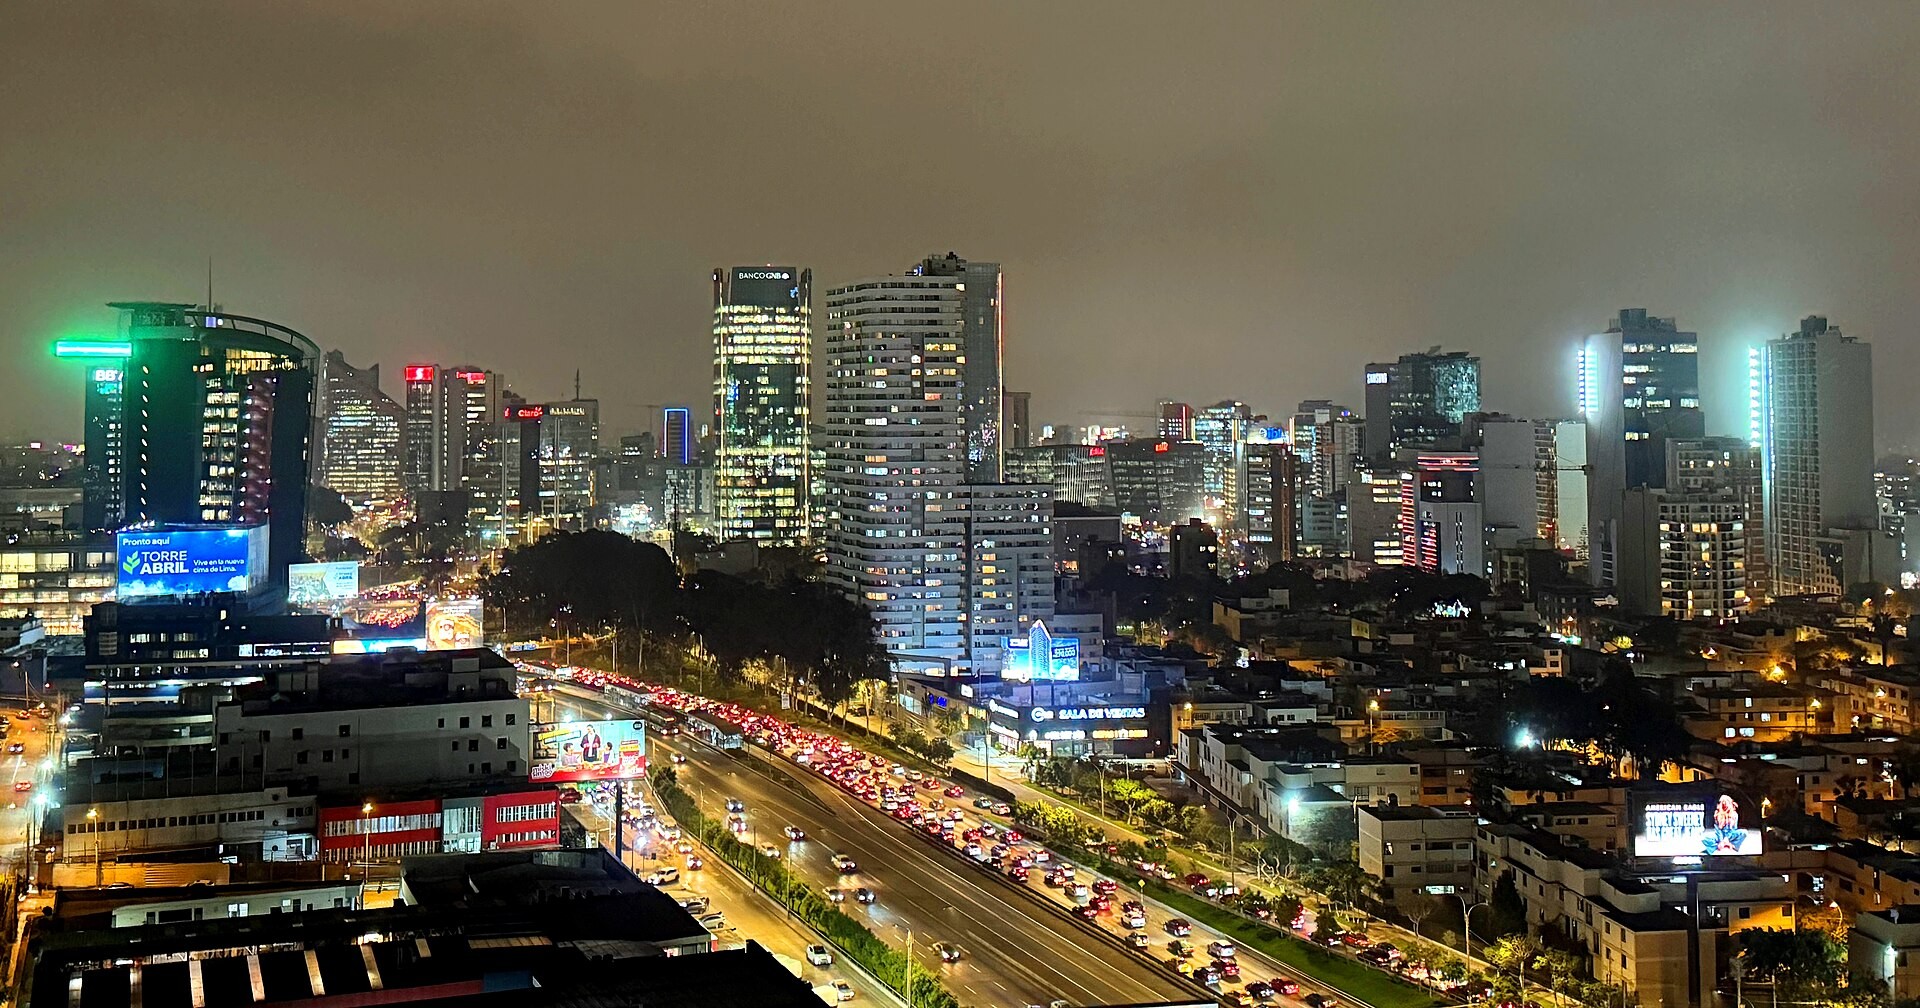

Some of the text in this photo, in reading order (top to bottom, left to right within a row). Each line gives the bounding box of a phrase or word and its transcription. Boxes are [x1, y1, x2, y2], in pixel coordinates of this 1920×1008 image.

[518, 409, 539, 417] Claro
[122, 538, 151, 546] Pronto
[141, 550, 187, 562] TORRE
[140, 562, 189, 574] ABRIL
[1059, 708, 1087, 720] SALA
[1088, 708, 1104, 719] DE
[1104, 707, 1145, 719] VENTAS
